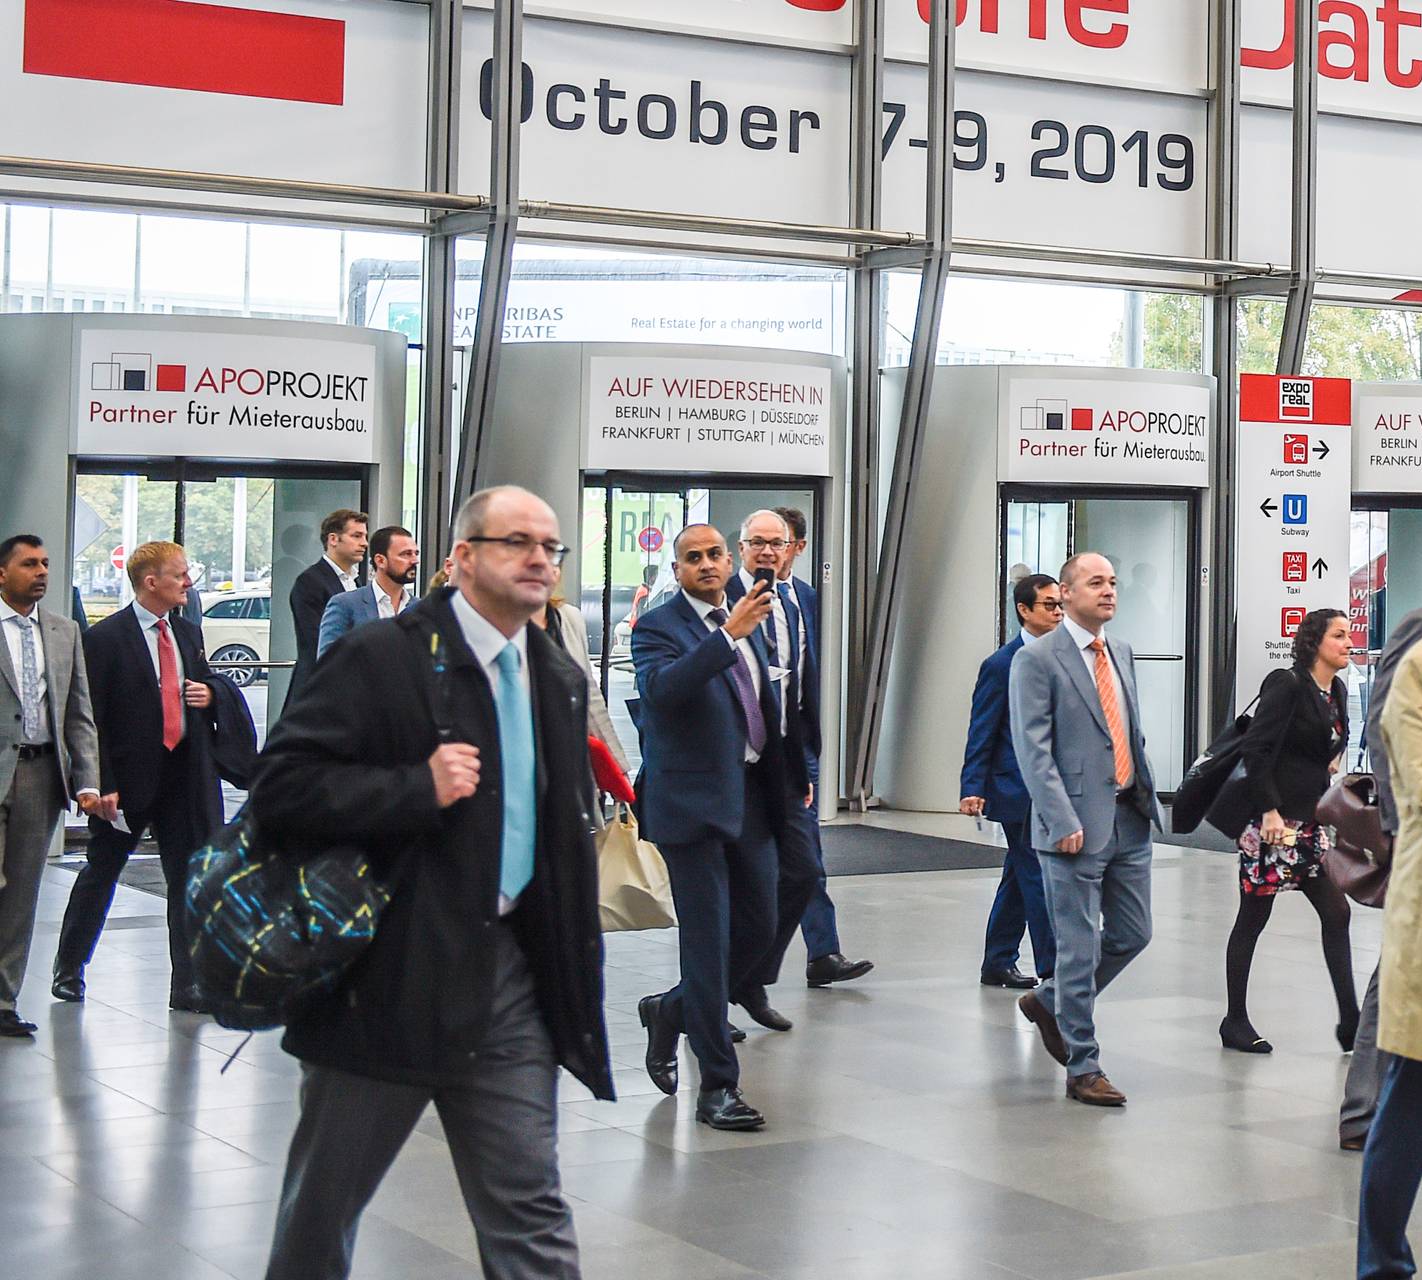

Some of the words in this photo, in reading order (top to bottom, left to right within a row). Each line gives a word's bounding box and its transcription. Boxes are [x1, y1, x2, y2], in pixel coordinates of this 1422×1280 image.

[1031, 120, 1194, 191] 2019
[507, 307, 563, 321] RIBAS
[631, 317, 656, 329] Real
[660, 317, 696, 329] Estate
[699, 317, 716, 332] for
[720, 321, 727, 329] a
[731, 317, 784, 332] changing
[788, 317, 823, 329] world
[194, 367, 368, 401] APOPROJEKT
[608, 377, 653, 397] AUF
[662, 377, 805, 404] WIEDERSEHEN
[809, 386, 823, 405] IN
[1282, 382, 1310, 397] expo
[89, 401, 177, 424] Partner
[187, 400, 220, 425] für
[229, 405, 368, 433] Mieterausbau.
[615, 406, 661, 419] BERLIN
[679, 407, 746, 422] HAMBURG
[761, 408, 818, 426] DÜSSELDORF
[1099, 410, 1206, 437] APOPROJEKT
[1375, 414, 1411, 431] AUF
[602, 427, 680, 440] FRANKFURT
[698, 428, 765, 443] STUTTGART
[779, 430, 824, 446] MÜNCHEN
[1381, 438, 1417, 449] BERLIN
[1020, 438, 1087, 457] Partner
[1094, 437, 1117, 457] für
[1124, 441, 1206, 462] Mieterausbau.
[1270, 468, 1294, 478] Airport
[1296, 469, 1321, 478] Shuttle
[1288, 499, 1302, 519] U
[1281, 527, 1309, 537] Subway
[1287, 554, 1303, 563] TAXI
[1286, 586, 1301, 594] Taxi
[1264, 641, 1290, 649] Shuttle
